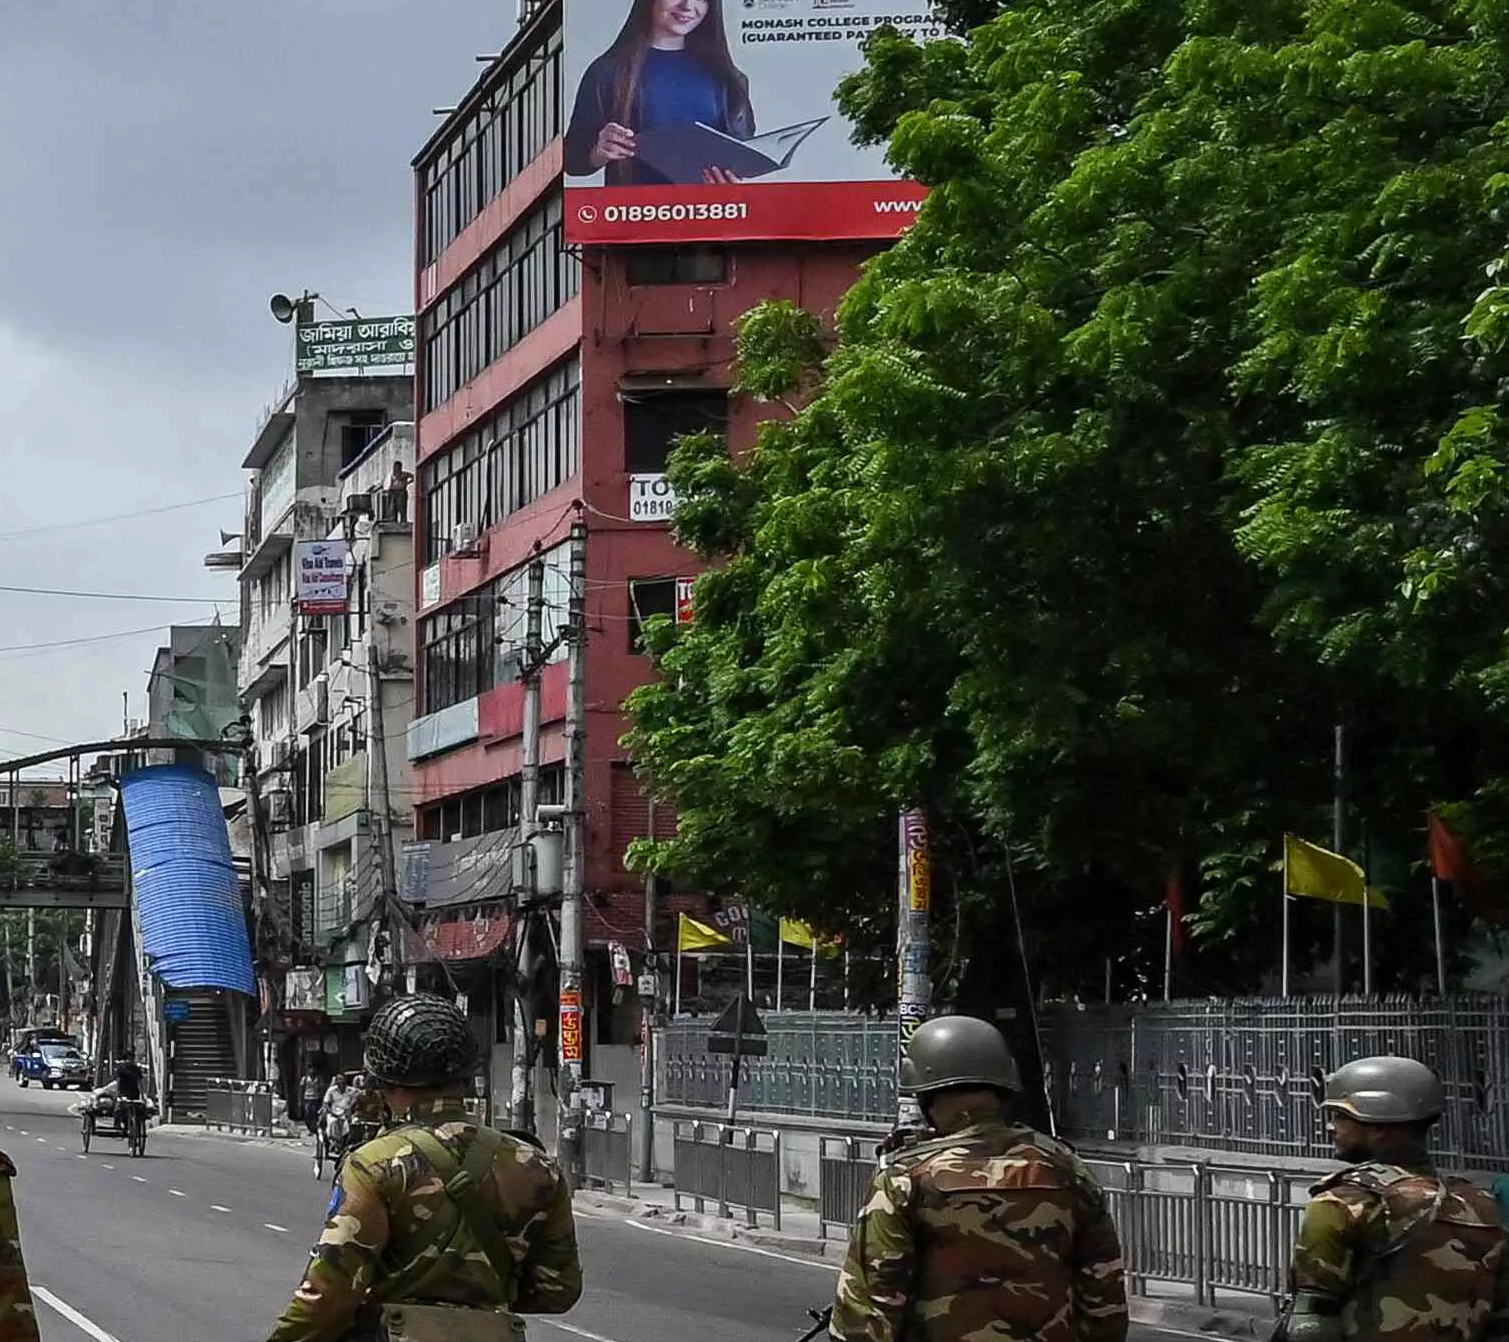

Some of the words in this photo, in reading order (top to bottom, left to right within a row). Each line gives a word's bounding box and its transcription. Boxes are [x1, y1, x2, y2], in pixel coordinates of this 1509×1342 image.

[741, 18, 804, 30] MONASH
[807, 16, 870, 28] COLLEGE
[741, 30, 843, 44] (GUARANTEED
[604, 202, 748, 222] 01896013881
[299, 322, 353, 343] জামিয়া
[635, 479, 670, 497] TO
